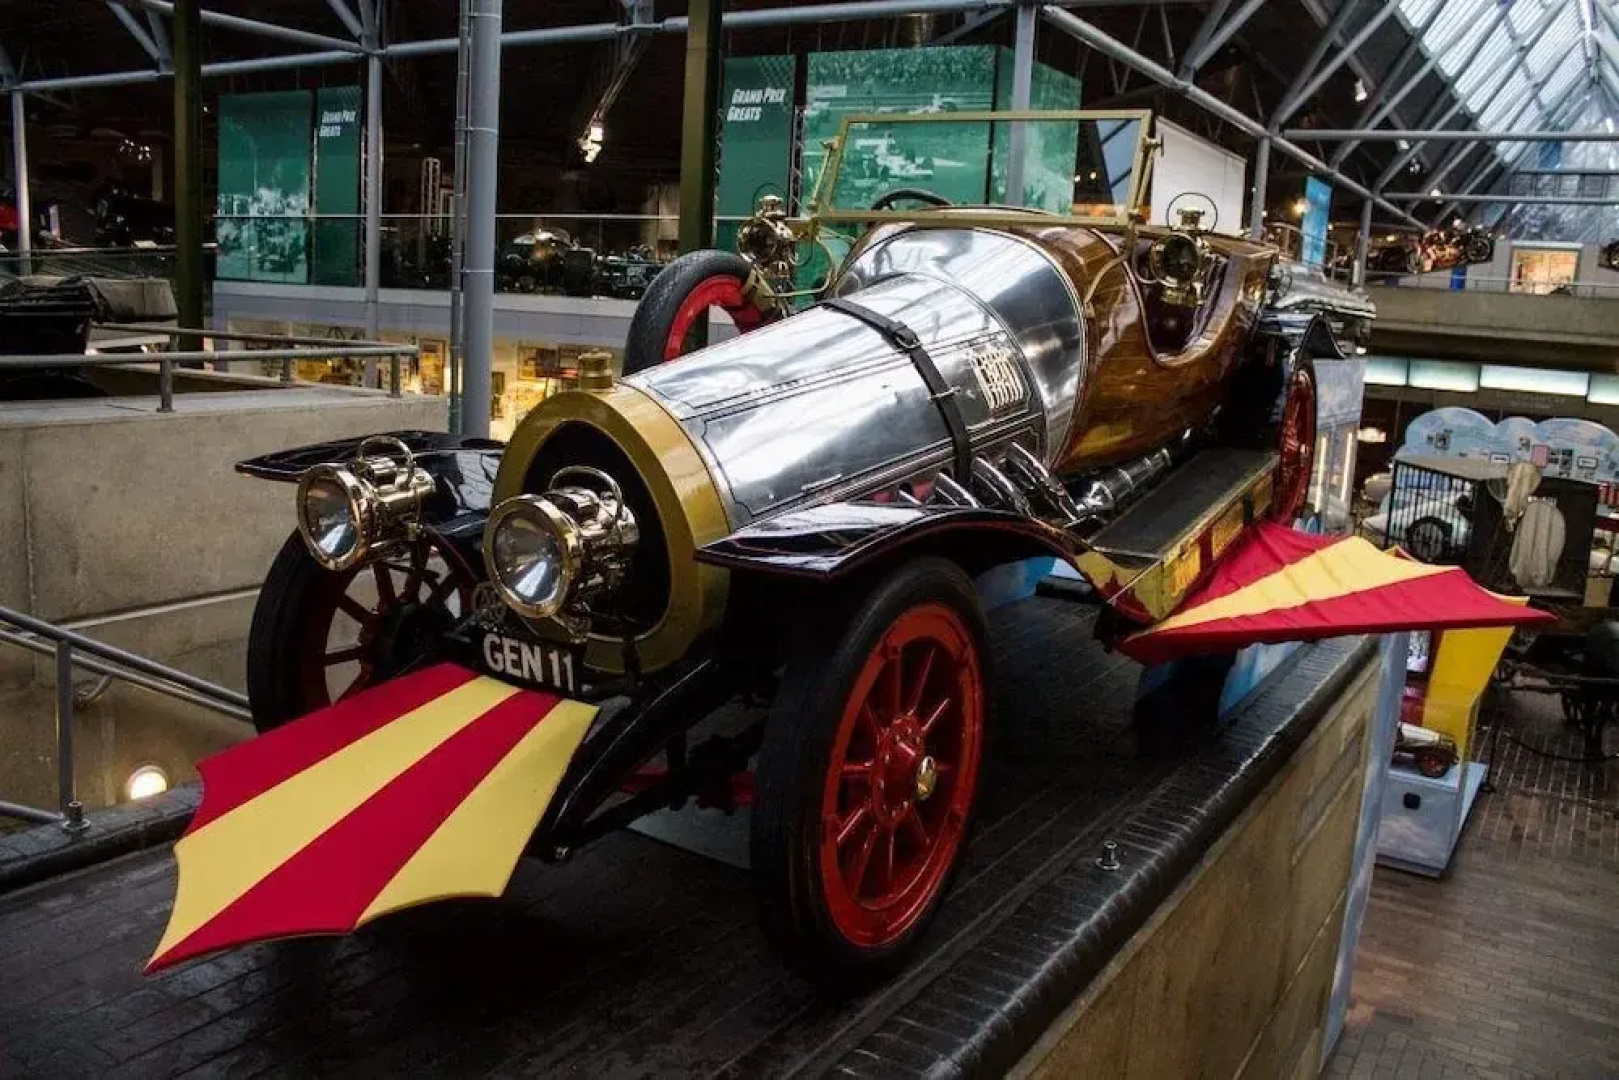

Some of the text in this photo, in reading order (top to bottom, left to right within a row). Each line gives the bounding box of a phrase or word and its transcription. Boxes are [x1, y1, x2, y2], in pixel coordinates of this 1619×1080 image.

[731, 87, 786, 104] GRAND PRIX
[727, 106, 762, 121] GREATS
[483, 632, 574, 693] GEN 11
